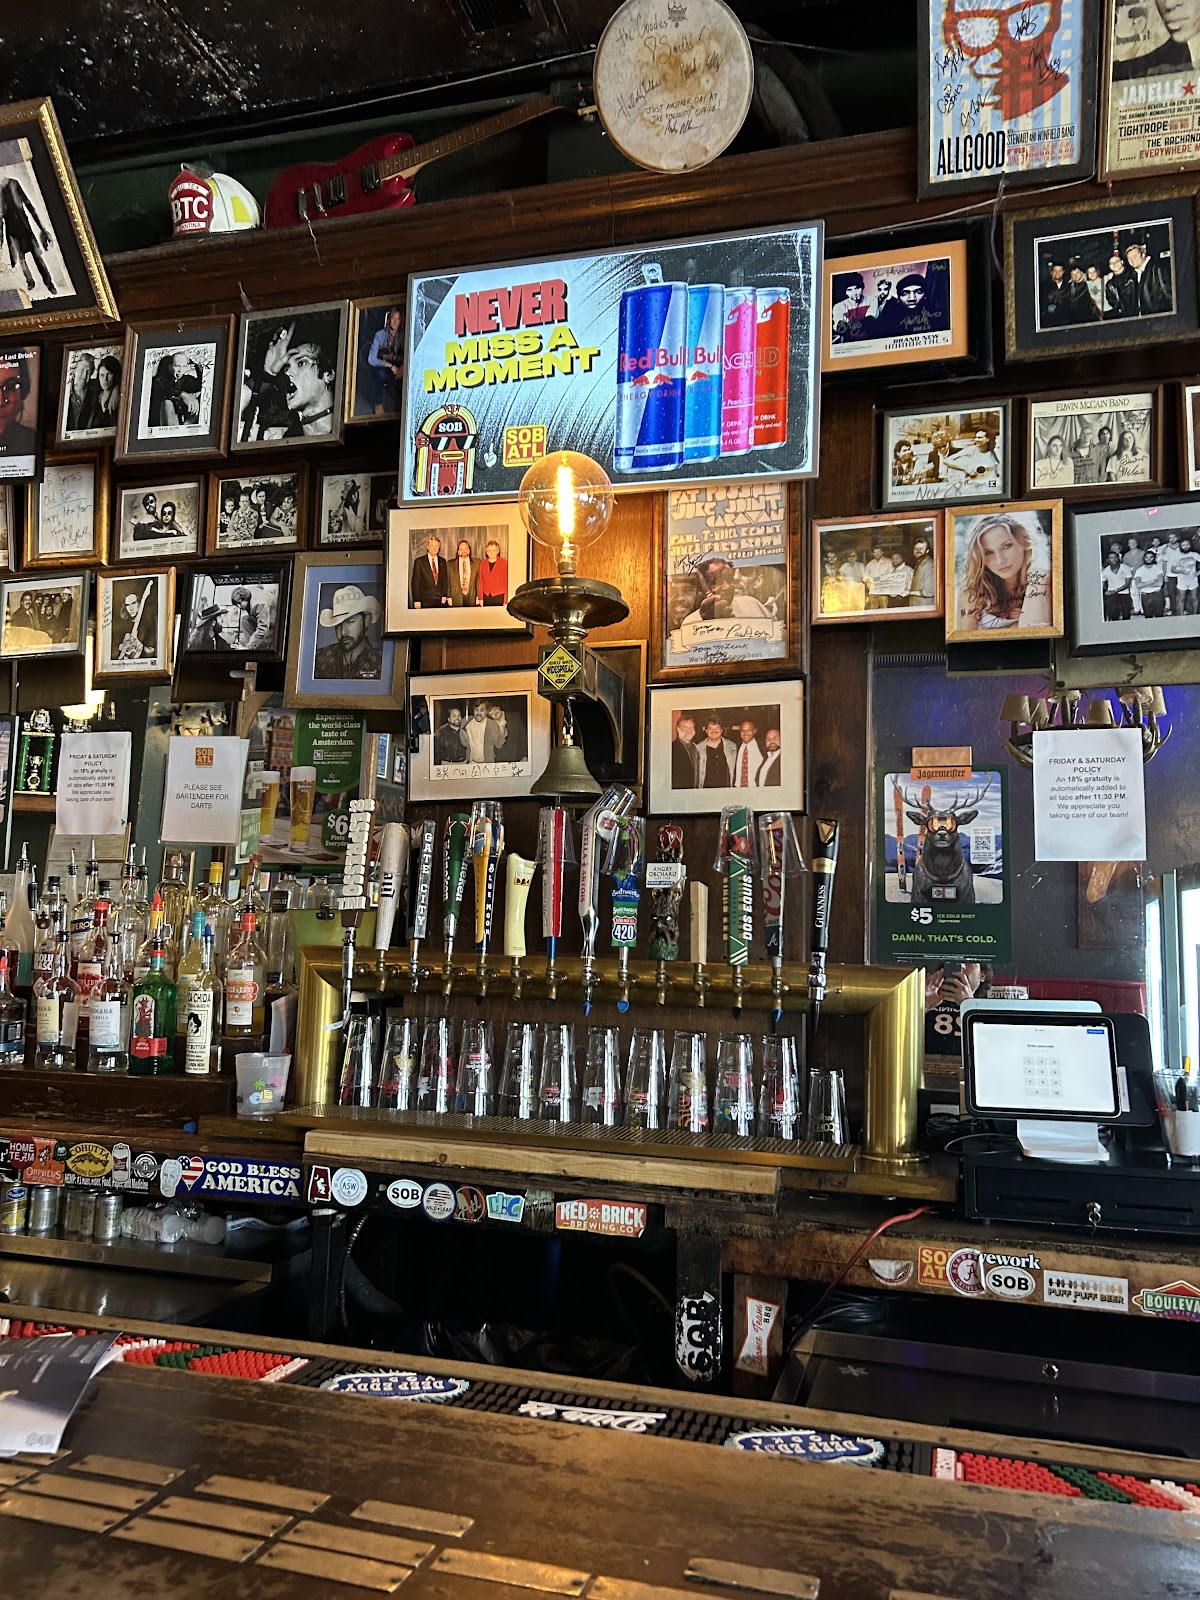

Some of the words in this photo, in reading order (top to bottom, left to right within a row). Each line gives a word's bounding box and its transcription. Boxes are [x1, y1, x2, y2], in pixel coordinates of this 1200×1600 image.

[1118, 78, 1184, 107] JANELLE
[1007, 132, 1029, 146] STEWART
[1061, 125, 1075, 138] BAND
[1118, 120, 1169, 138] TIGHTROPE
[1139, 143, 1192, 159] EVERYWHERE
[1147, 138, 1162, 149] THE
[936, 130, 1006, 176] ALLGOOD
[171, 196, 209, 224] BTC
[455, 278, 568, 337] NEVER
[445, 330, 543, 366] MISS
[545, 325, 580, 350] A
[893, 336, 920, 344] BRAND
[923, 333, 940, 341] NEW
[5, 353, 17, 361] Last
[619, 347, 653, 372] Red
[423, 345, 600, 394] MOMENT
[1056, 401, 1079, 412] EDWIN
[438, 420, 463, 434] SOB
[507, 427, 544, 445] SOB
[507, 444, 543, 460] ATL
[670, 500, 717, 521] JUKE
[315, 713, 355, 722] Experience
[321, 721, 361, 729] world-class
[312, 738, 355, 746] Amsterdam.
[321, 730, 339, 738] taste
[339, 730, 348, 738] of
[196, 748, 213, 756] SOB
[1085, 756, 1127, 764] SATURDAY
[184, 783, 209, 791] PLEASE
[209, 783, 222, 791] SEE
[1084, 775, 1113, 784] gratuity
[1050, 784, 1095, 793] automatically
[215, 793, 229, 801] FOR
[190, 802, 213, 810] DARTS
[349, 799, 375, 812] SOB
[1070, 803, 1106, 811] appreciate
[1107, 803, 1121, 811] you
[1049, 812, 1070, 820] taking
[1109, 811, 1129, 819] team!
[327, 813, 349, 836] $6
[582, 826, 590, 861] STELLA
[342, 812, 371, 897] ESPRESSO
[421, 832, 434, 875] GATE
[487, 863, 495, 899] BLUE
[580, 870, 589, 903] ARTOIS
[742, 875, 753, 913] EQUIS
[417, 883, 429, 926] CITY
[814, 884, 826, 928] GUINNESS
[484, 903, 492, 936] MOON
[910, 907, 934, 925] $5
[613, 924, 635, 941] 420
[742, 915, 753, 941] DOS
[891, 933, 926, 943] DAMN,
[927, 934, 965, 943] THAT'S
[965, 935, 997, 944] COLD.
[9, 1142, 35, 1152] HOME
[69, 1143, 110, 1160] COHUTTA
[9, 1151, 35, 1162] TEAM
[26, 1166, 61, 1180] ORPHEUS
[205, 1161, 243, 1174] GOD
[247, 1163, 301, 1179] BLESS
[201, 1174, 300, 1197] AMERICA
[342, 1182, 357, 1190] ASW
[391, 1187, 420, 1200] SOB
[560, 1201, 588, 1221] RED
[601, 1204, 645, 1228] BRICK
[570, 1220, 616, 1232] BREWING
[619, 1225, 634, 1233] CO
[921, 1249, 950, 1264] SO
[923, 1266, 948, 1279] AT
[991, 1274, 1030, 1291] SOB
[1048, 1287, 1073, 1298] PUFF
[1073, 1290, 1099, 1301] PUFF
[1099, 1294, 1125, 1305] BEER
[752, 1303, 764, 1333] Team
[762, 1306, 772, 1324] BBQ
[686, 1300, 718, 1373] SOB
[346, 1379, 395, 1393] EDDY
[352, 1374, 437, 1383] VODKA
[398, 1379, 445, 1392] DEEP
[750, 1433, 842, 1446] VODKA
[809, 1439, 861, 1452] DEEP
